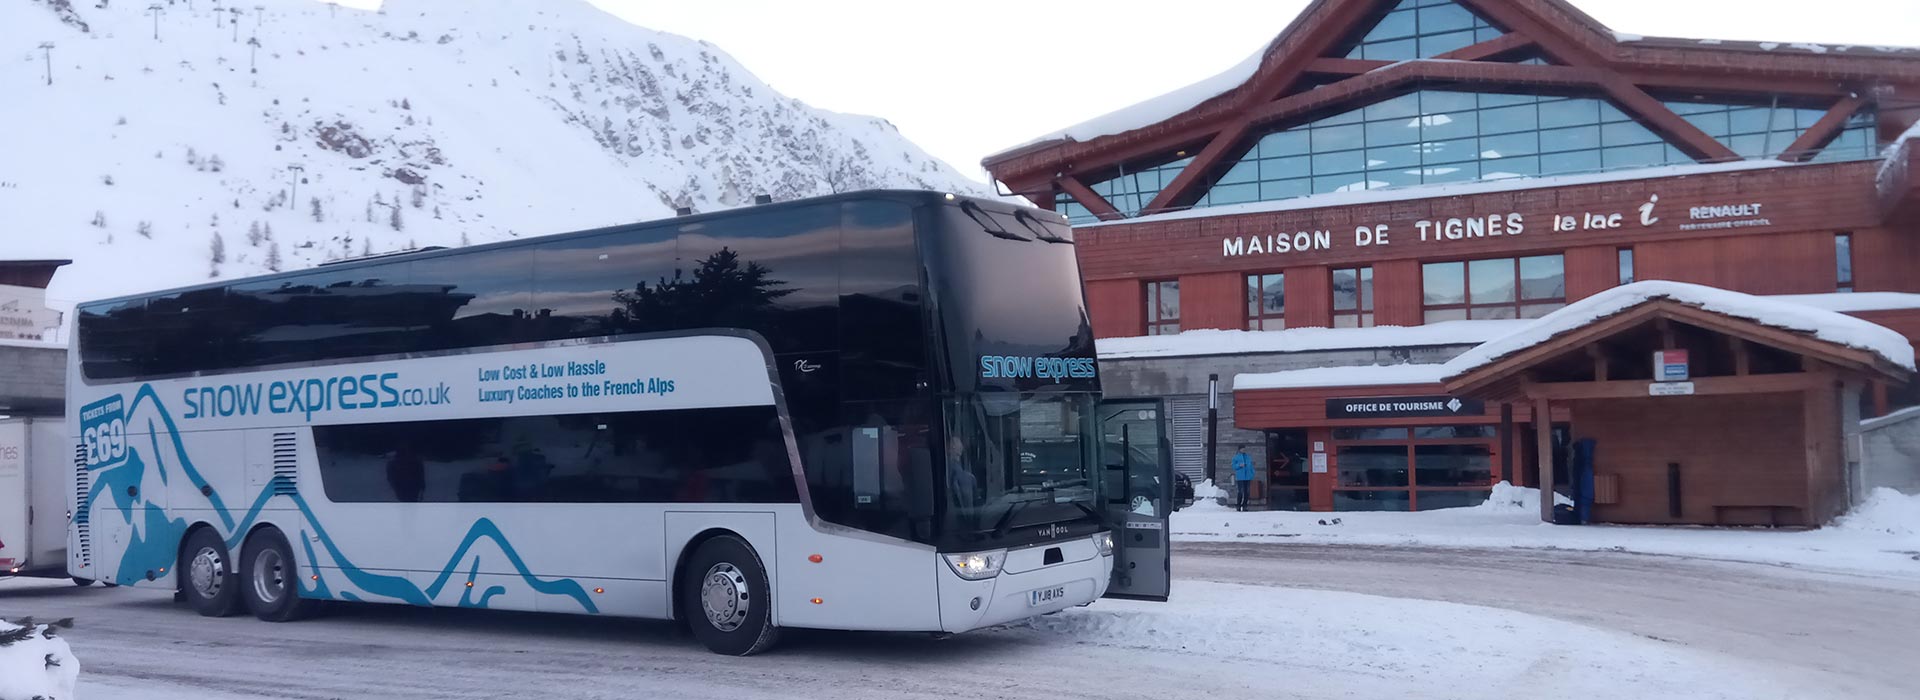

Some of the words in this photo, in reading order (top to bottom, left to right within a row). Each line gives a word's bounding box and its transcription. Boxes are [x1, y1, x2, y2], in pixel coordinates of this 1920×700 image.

[1689, 203, 1762, 220] RENAULT
[1222, 230, 1331, 257] MAISON
[1355, 224, 1389, 246] DE
[1415, 212, 1524, 241] TIGNES
[1553, 214, 1577, 232] le
[1583, 211, 1623, 230] lac
[478, 367, 499, 382] Low
[503, 365, 527, 380] Cost
[530, 364, 538, 379] &
[541, 363, 564, 378] Low
[568, 360, 606, 377] Hassle
[981, 355, 1032, 378] snow
[1034, 357, 1096, 384] express
[184, 383, 262, 419] snow
[478, 387, 514, 404] Luxury
[517, 384, 563, 401] Coaches
[566, 383, 578, 398] to
[582, 381, 600, 397] the
[604, 378, 644, 396] French
[647, 377, 675, 396] Alps
[1345, 403, 1377, 412] OFFICE
[1379, 402, 1391, 411] DE
[1393, 401, 1443, 411] TOURISME
[84, 418, 125, 466] £69
